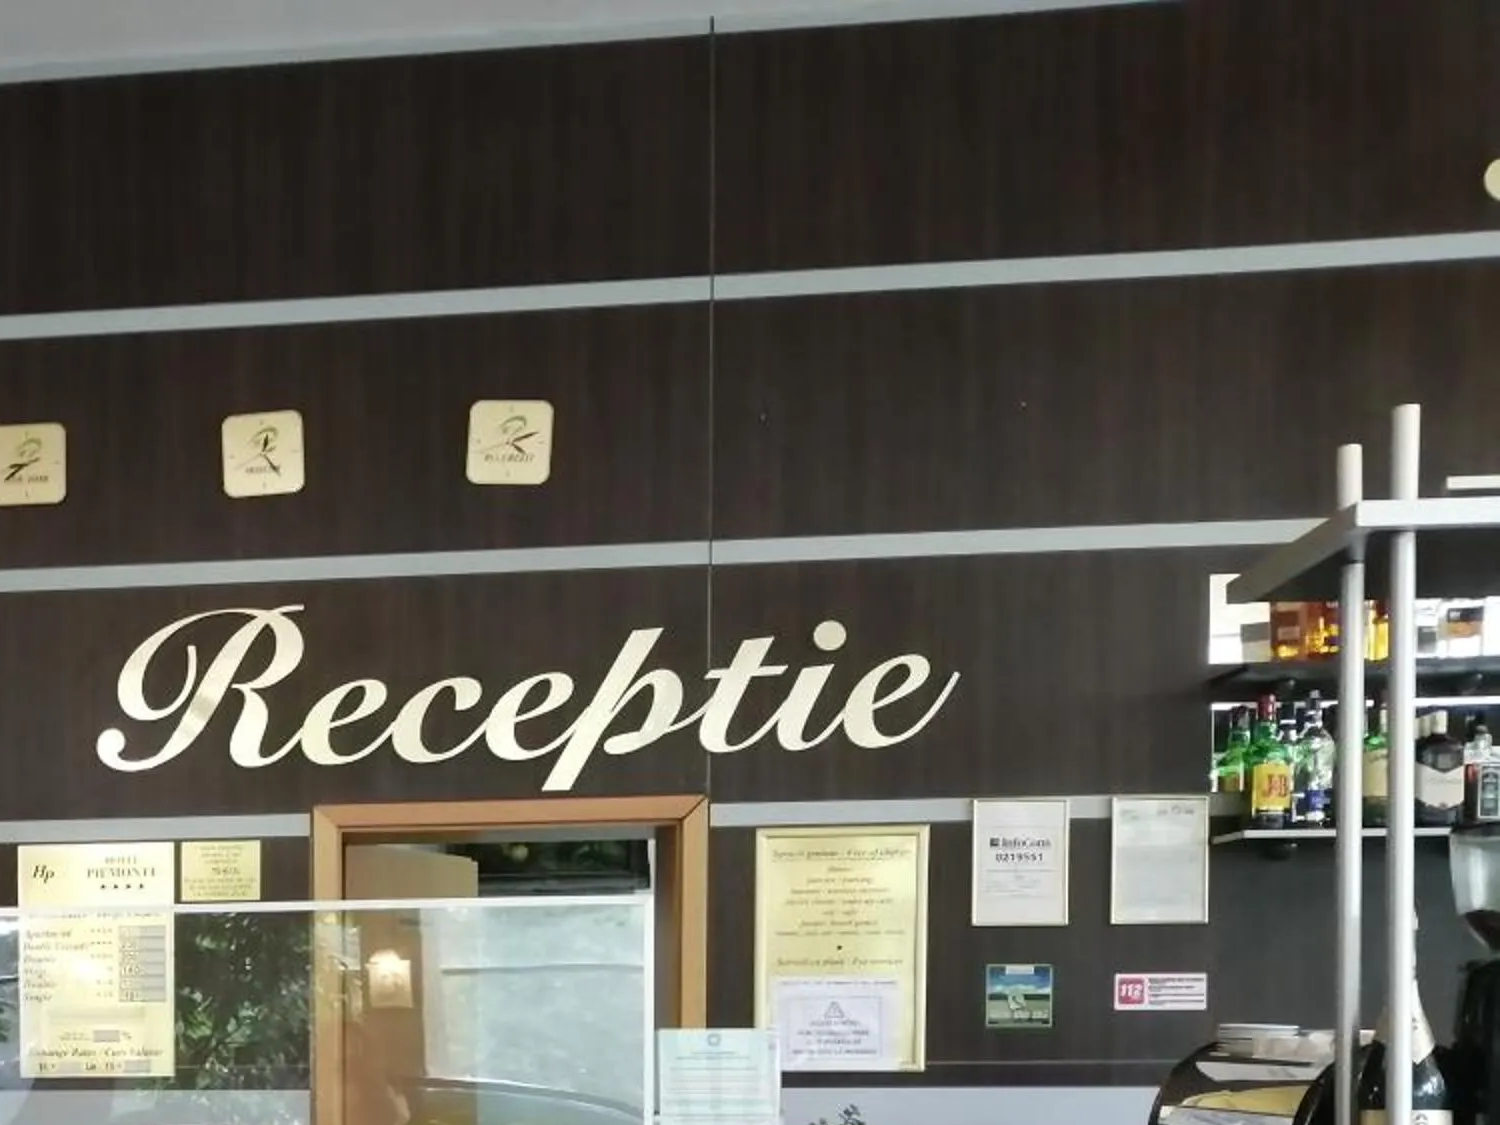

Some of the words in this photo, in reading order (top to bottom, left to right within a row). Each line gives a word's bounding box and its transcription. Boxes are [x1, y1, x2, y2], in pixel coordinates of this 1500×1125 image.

[96, 604, 960, 791] Receptie
[86, 867, 156, 879] PIEMONTE
[1120, 983, 1143, 997] 112
